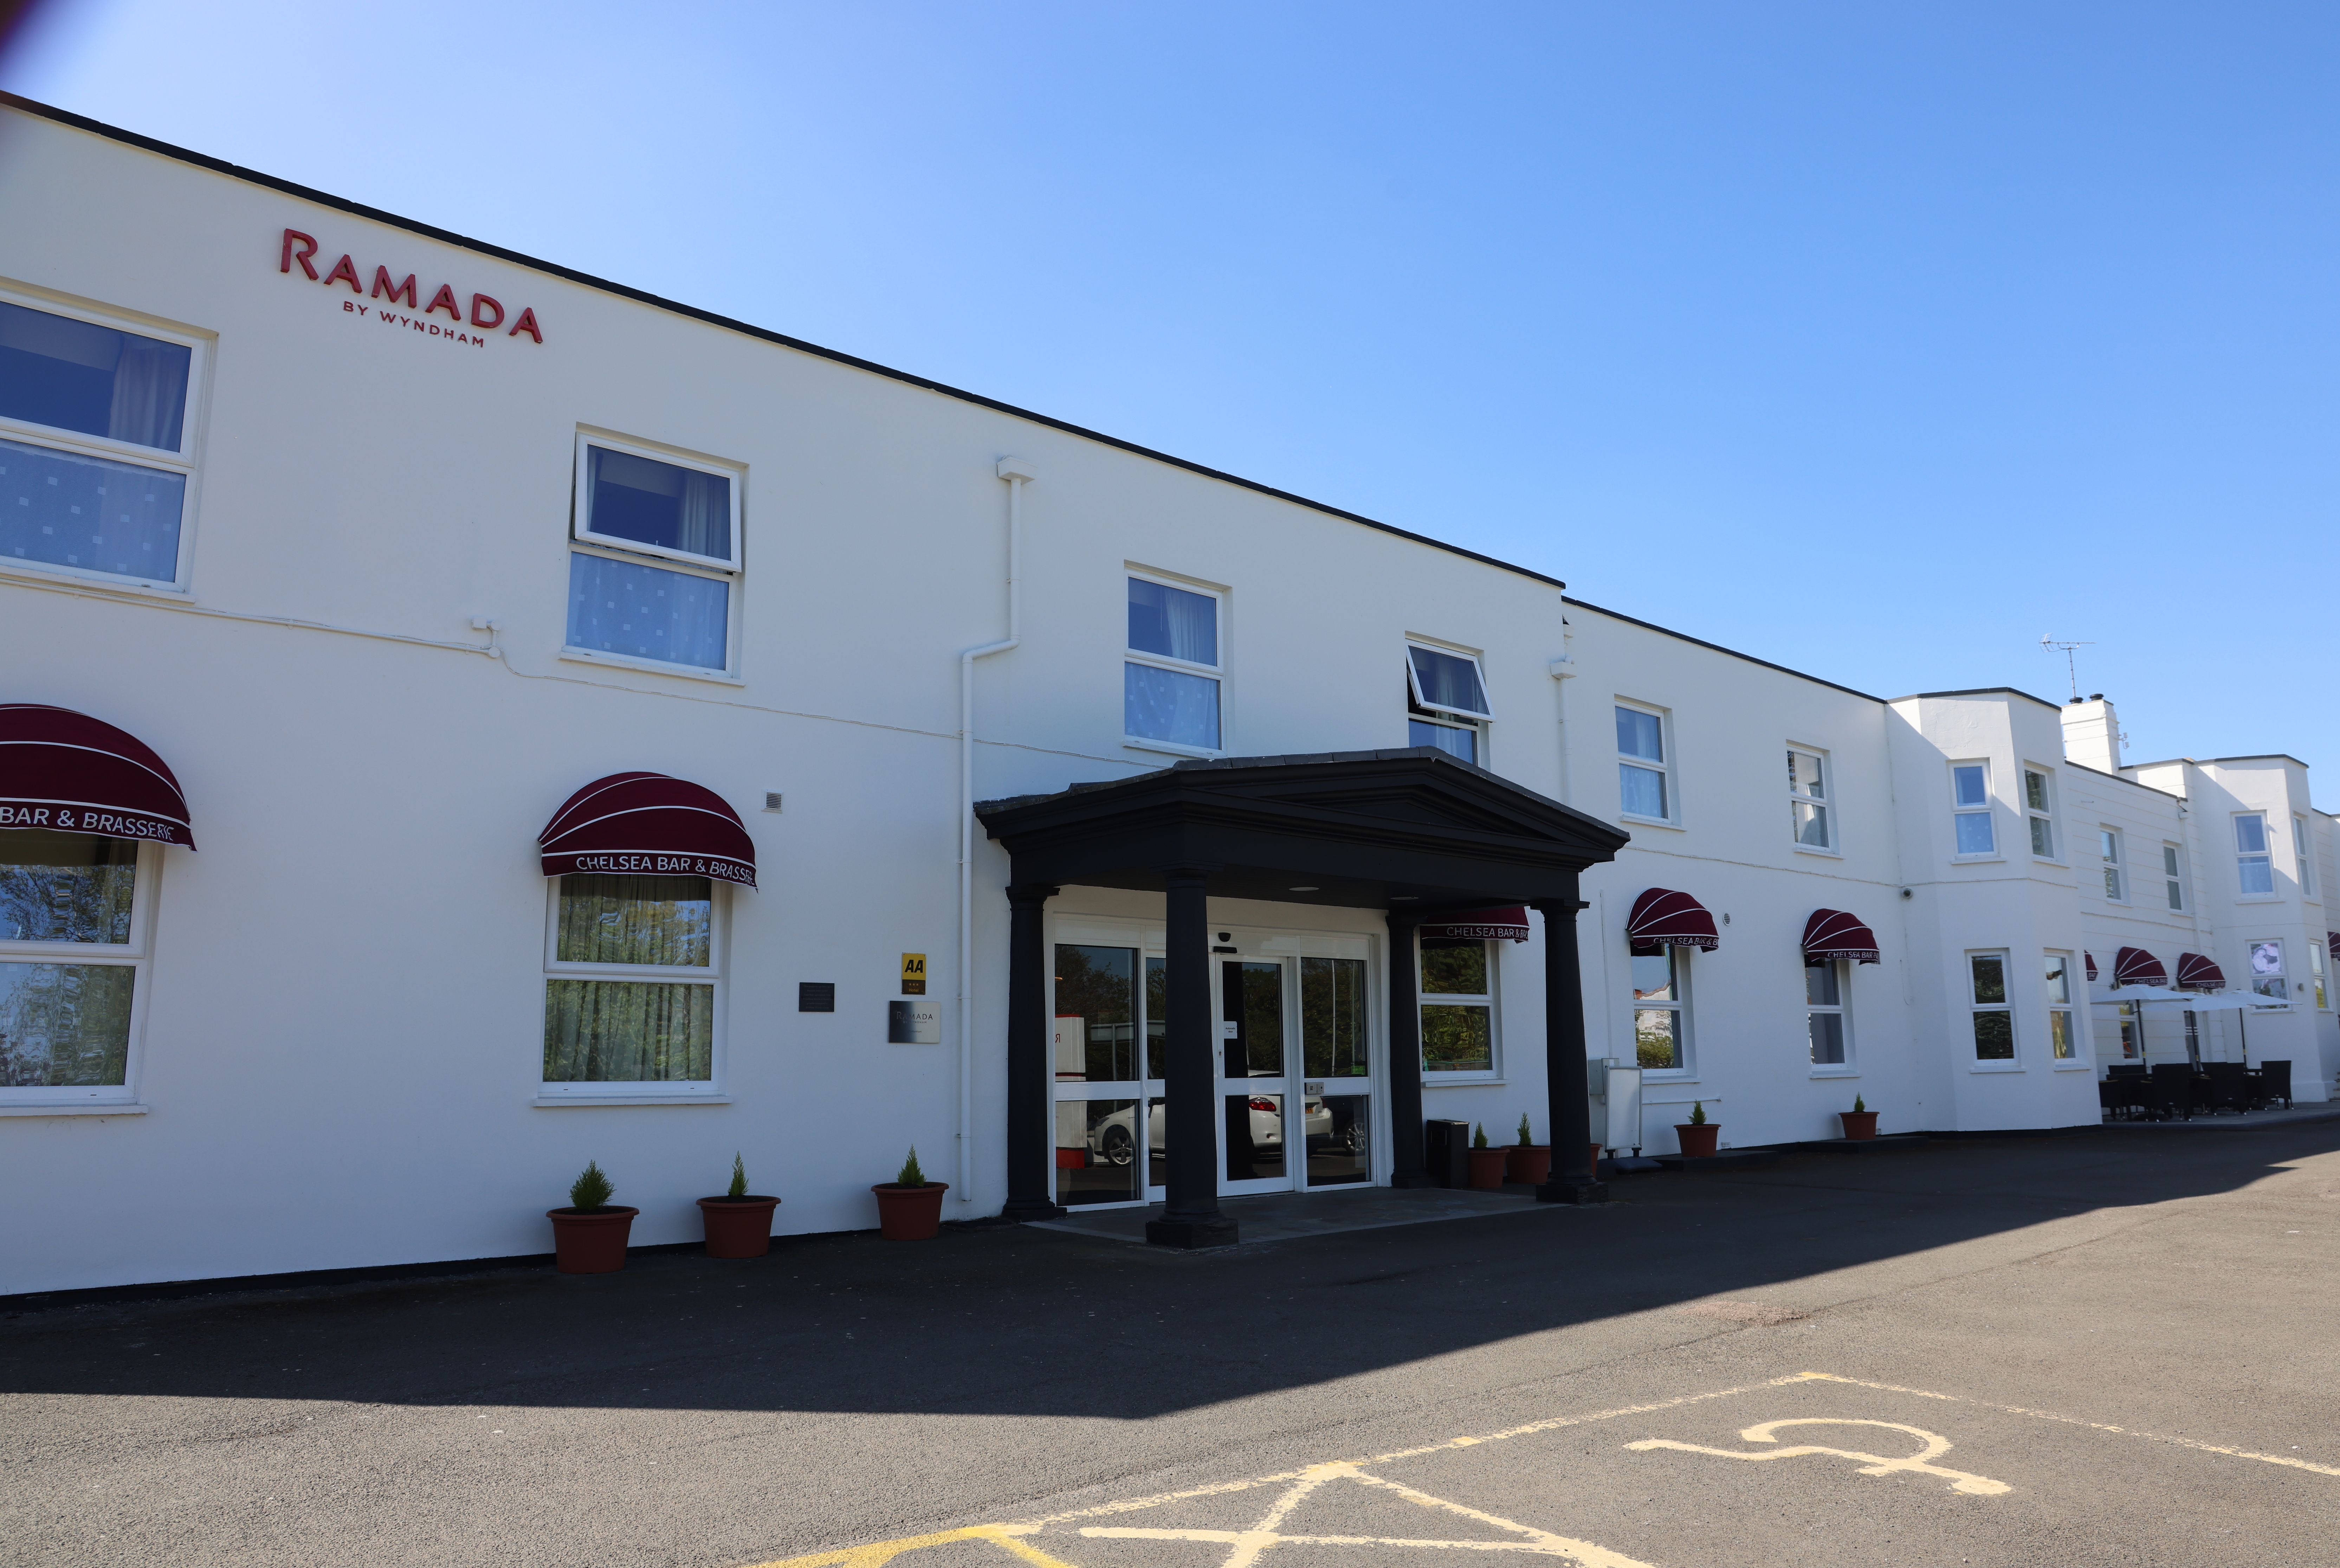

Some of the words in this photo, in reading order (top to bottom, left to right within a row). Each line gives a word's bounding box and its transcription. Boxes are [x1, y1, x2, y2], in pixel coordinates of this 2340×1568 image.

[280, 228, 543, 344] RAMADA
[343, 301, 368, 315] BY
[380, 311, 484, 348] WYNDHAM
[0, 807, 49, 825] BAR
[57, 810, 74, 827] &
[83, 812, 174, 841] BRASSERIE
[576, 856, 652, 870] CHELSEA
[658, 857, 690, 871] BAR
[695, 859, 706, 872] &
[1447, 927, 1495, 937] CHELSEA
[1498, 928, 1514, 937] BAR
[1515, 929, 1520, 937] &
[905, 960, 923, 973] AA
[897, 1012, 933, 1020] RAMADA
